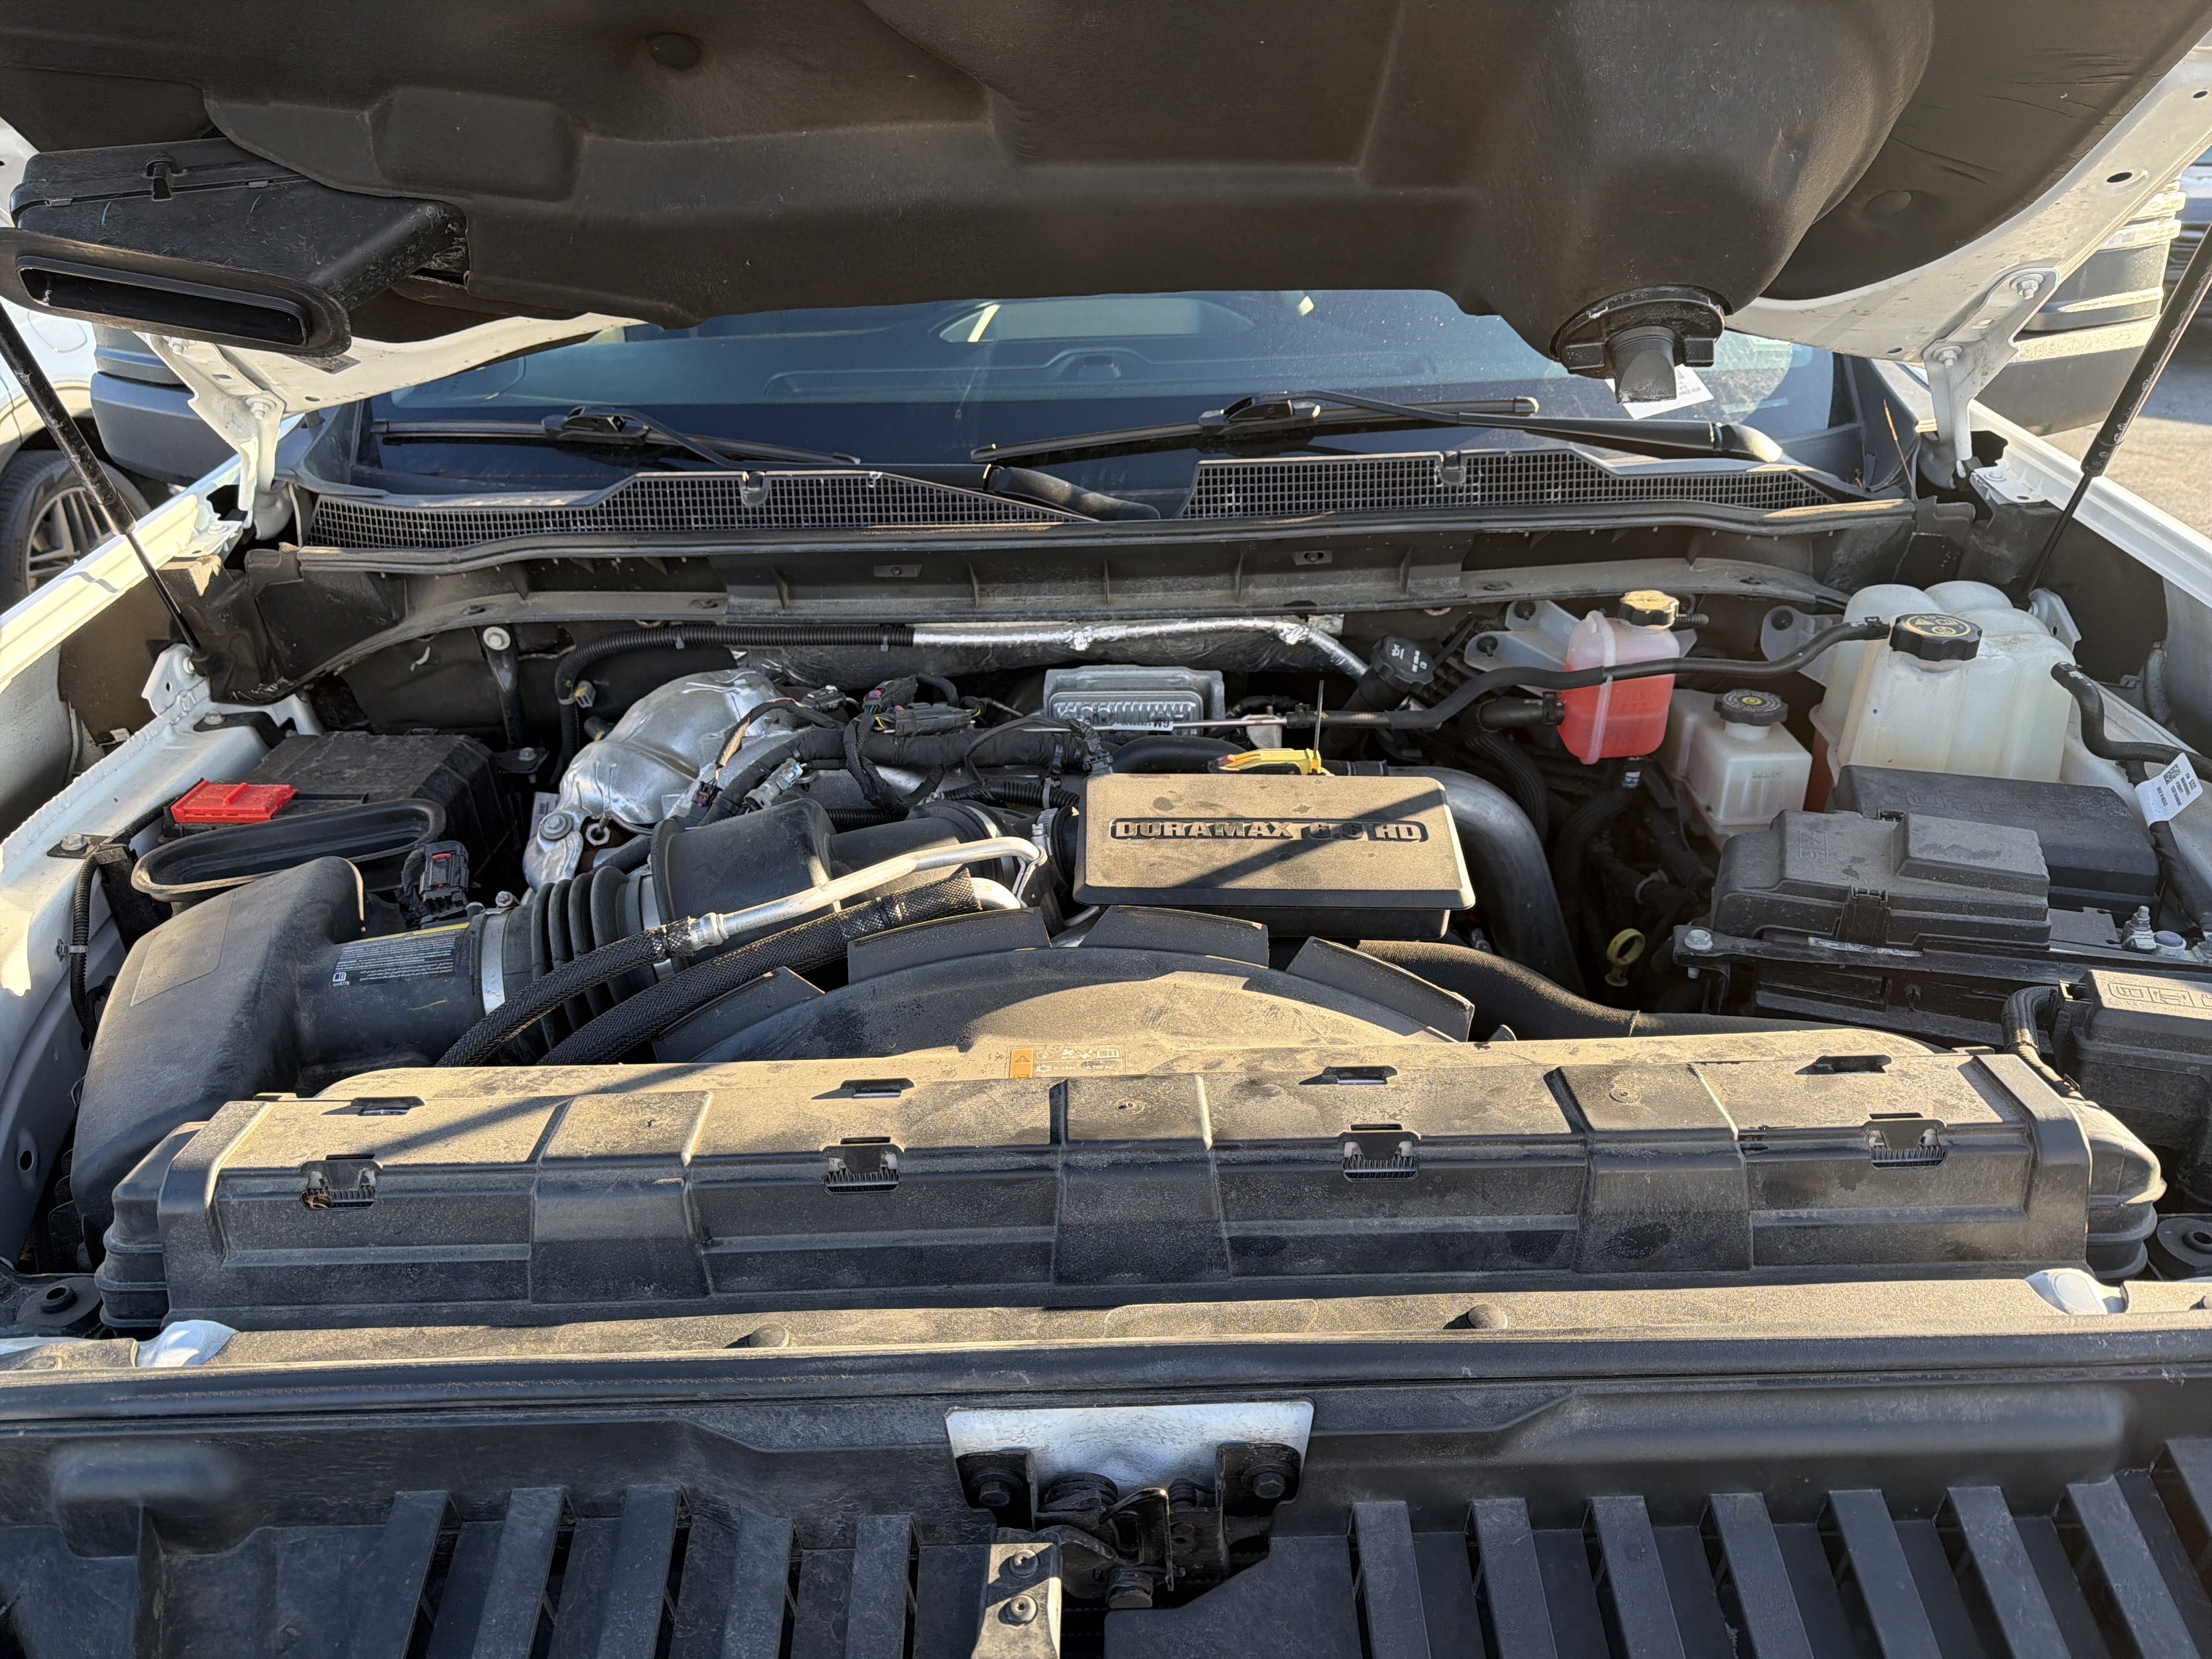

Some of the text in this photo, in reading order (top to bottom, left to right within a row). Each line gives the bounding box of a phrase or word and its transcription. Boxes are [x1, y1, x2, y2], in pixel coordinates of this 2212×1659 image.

[1115, 821, 1422, 840] DURAMAX 6.6 HD
